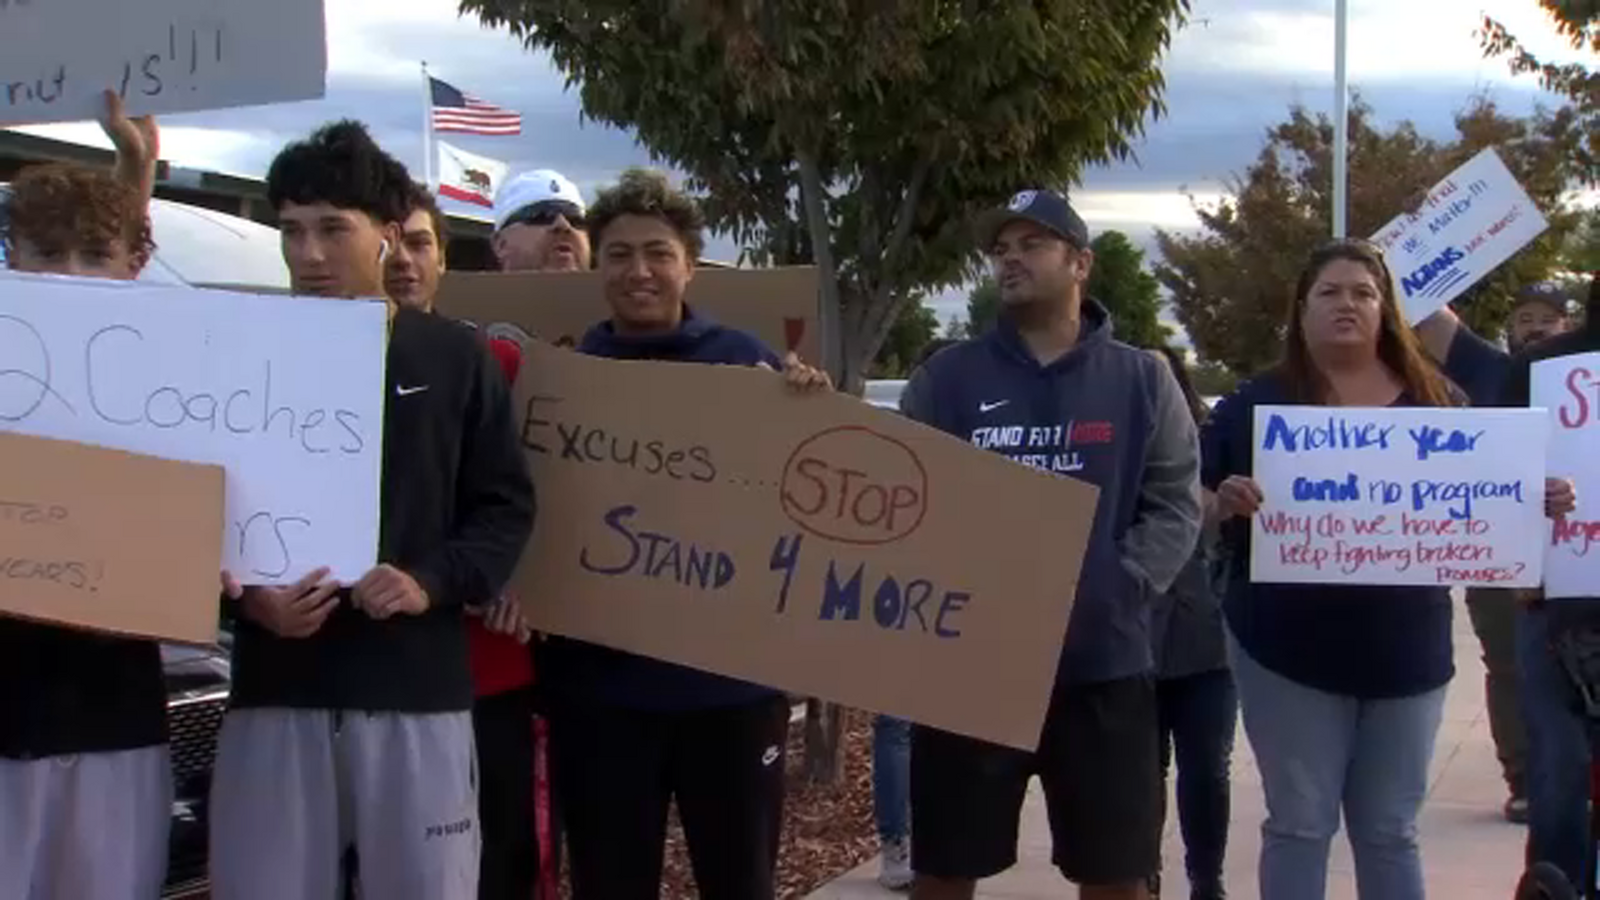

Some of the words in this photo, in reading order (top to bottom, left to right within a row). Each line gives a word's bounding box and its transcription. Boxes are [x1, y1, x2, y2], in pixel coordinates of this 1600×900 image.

[86, 325, 364, 453] Coaches
[972, 426, 1024, 449] STAND
[1262, 413, 1396, 452] Another
[1408, 425, 1486, 461] year
[785, 458, 918, 531] STOP
[1293, 472, 1360, 502] and
[1368, 479, 1403, 505] no
[1412, 479, 1524, 520] program
[1259, 512, 1312, 546] Why
[1316, 513, 1346, 539] do
[1352, 514, 1393, 537] we
[1401, 512, 1459, 538] have
[1459, 516, 1490, 537] to
[580, 505, 736, 589] STAND
[769, 533, 804, 614] 4
[818, 560, 971, 639] MORE
[1334, 540, 1412, 576] fighting
[1416, 541, 1494, 566] broken
